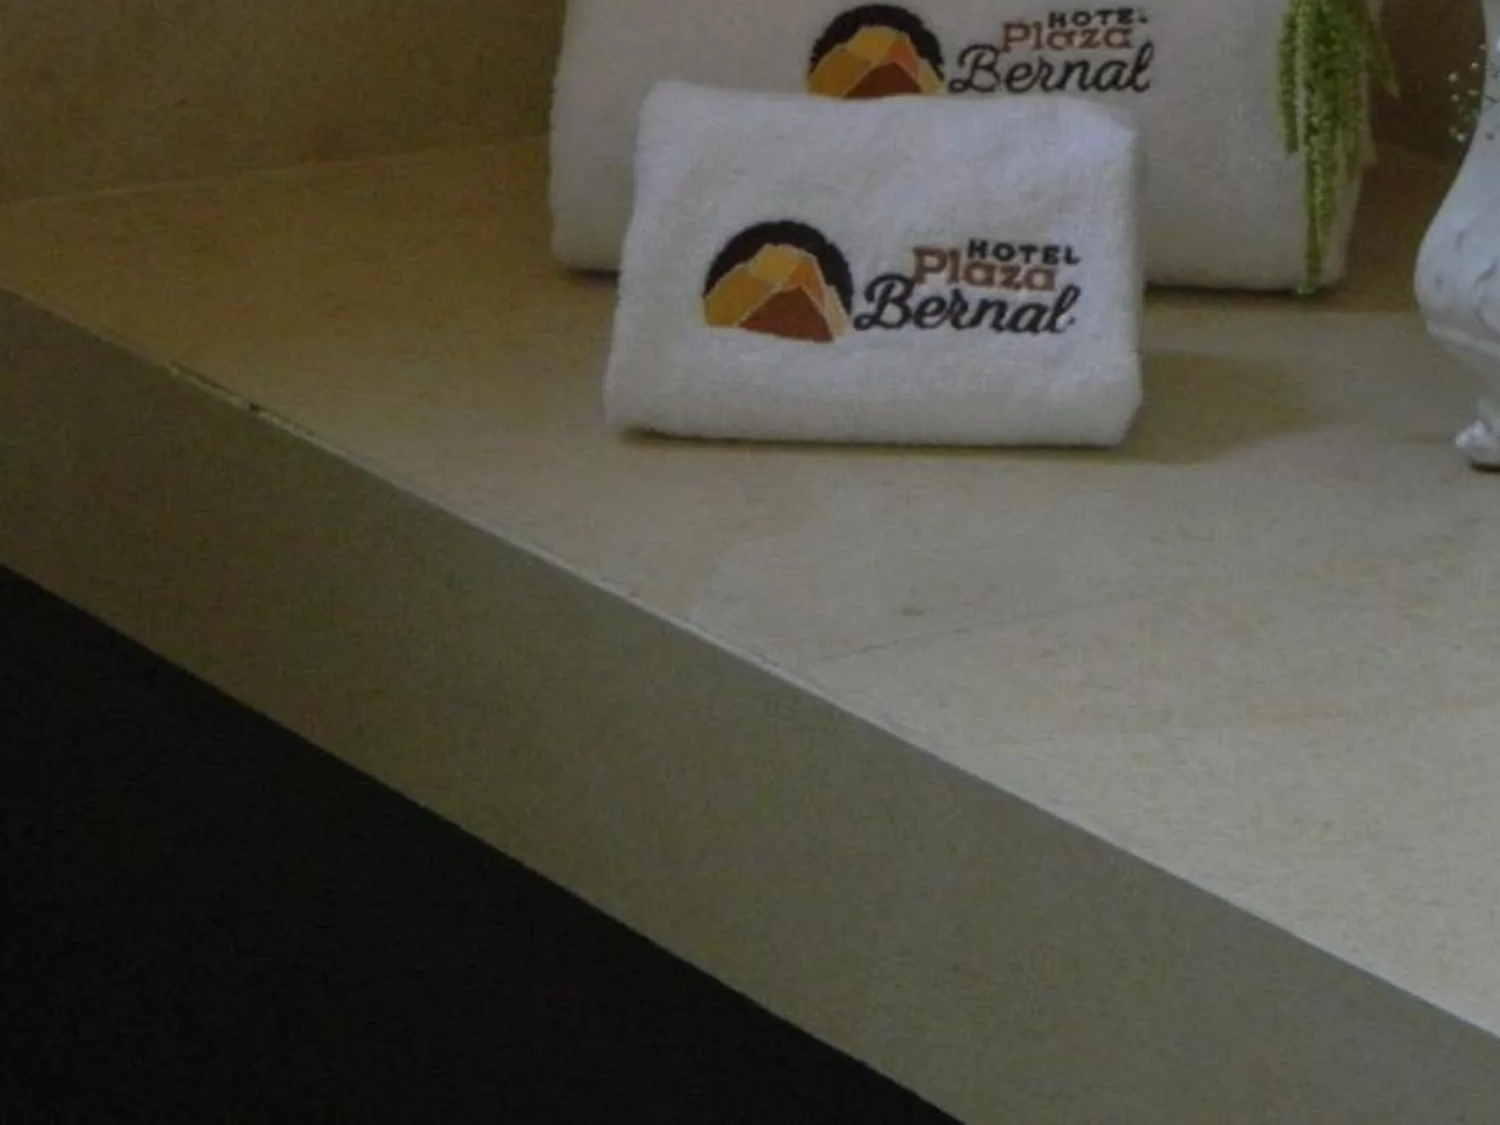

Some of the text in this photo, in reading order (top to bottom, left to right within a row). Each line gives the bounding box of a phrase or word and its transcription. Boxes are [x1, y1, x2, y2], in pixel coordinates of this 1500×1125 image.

[1002, 20, 1134, 53] Plaza
[947, 42, 1155, 94] Bernal
[911, 246, 1060, 293] Plaza
[967, 237, 1082, 266] HOTEL
[852, 274, 1082, 334] Bernal
